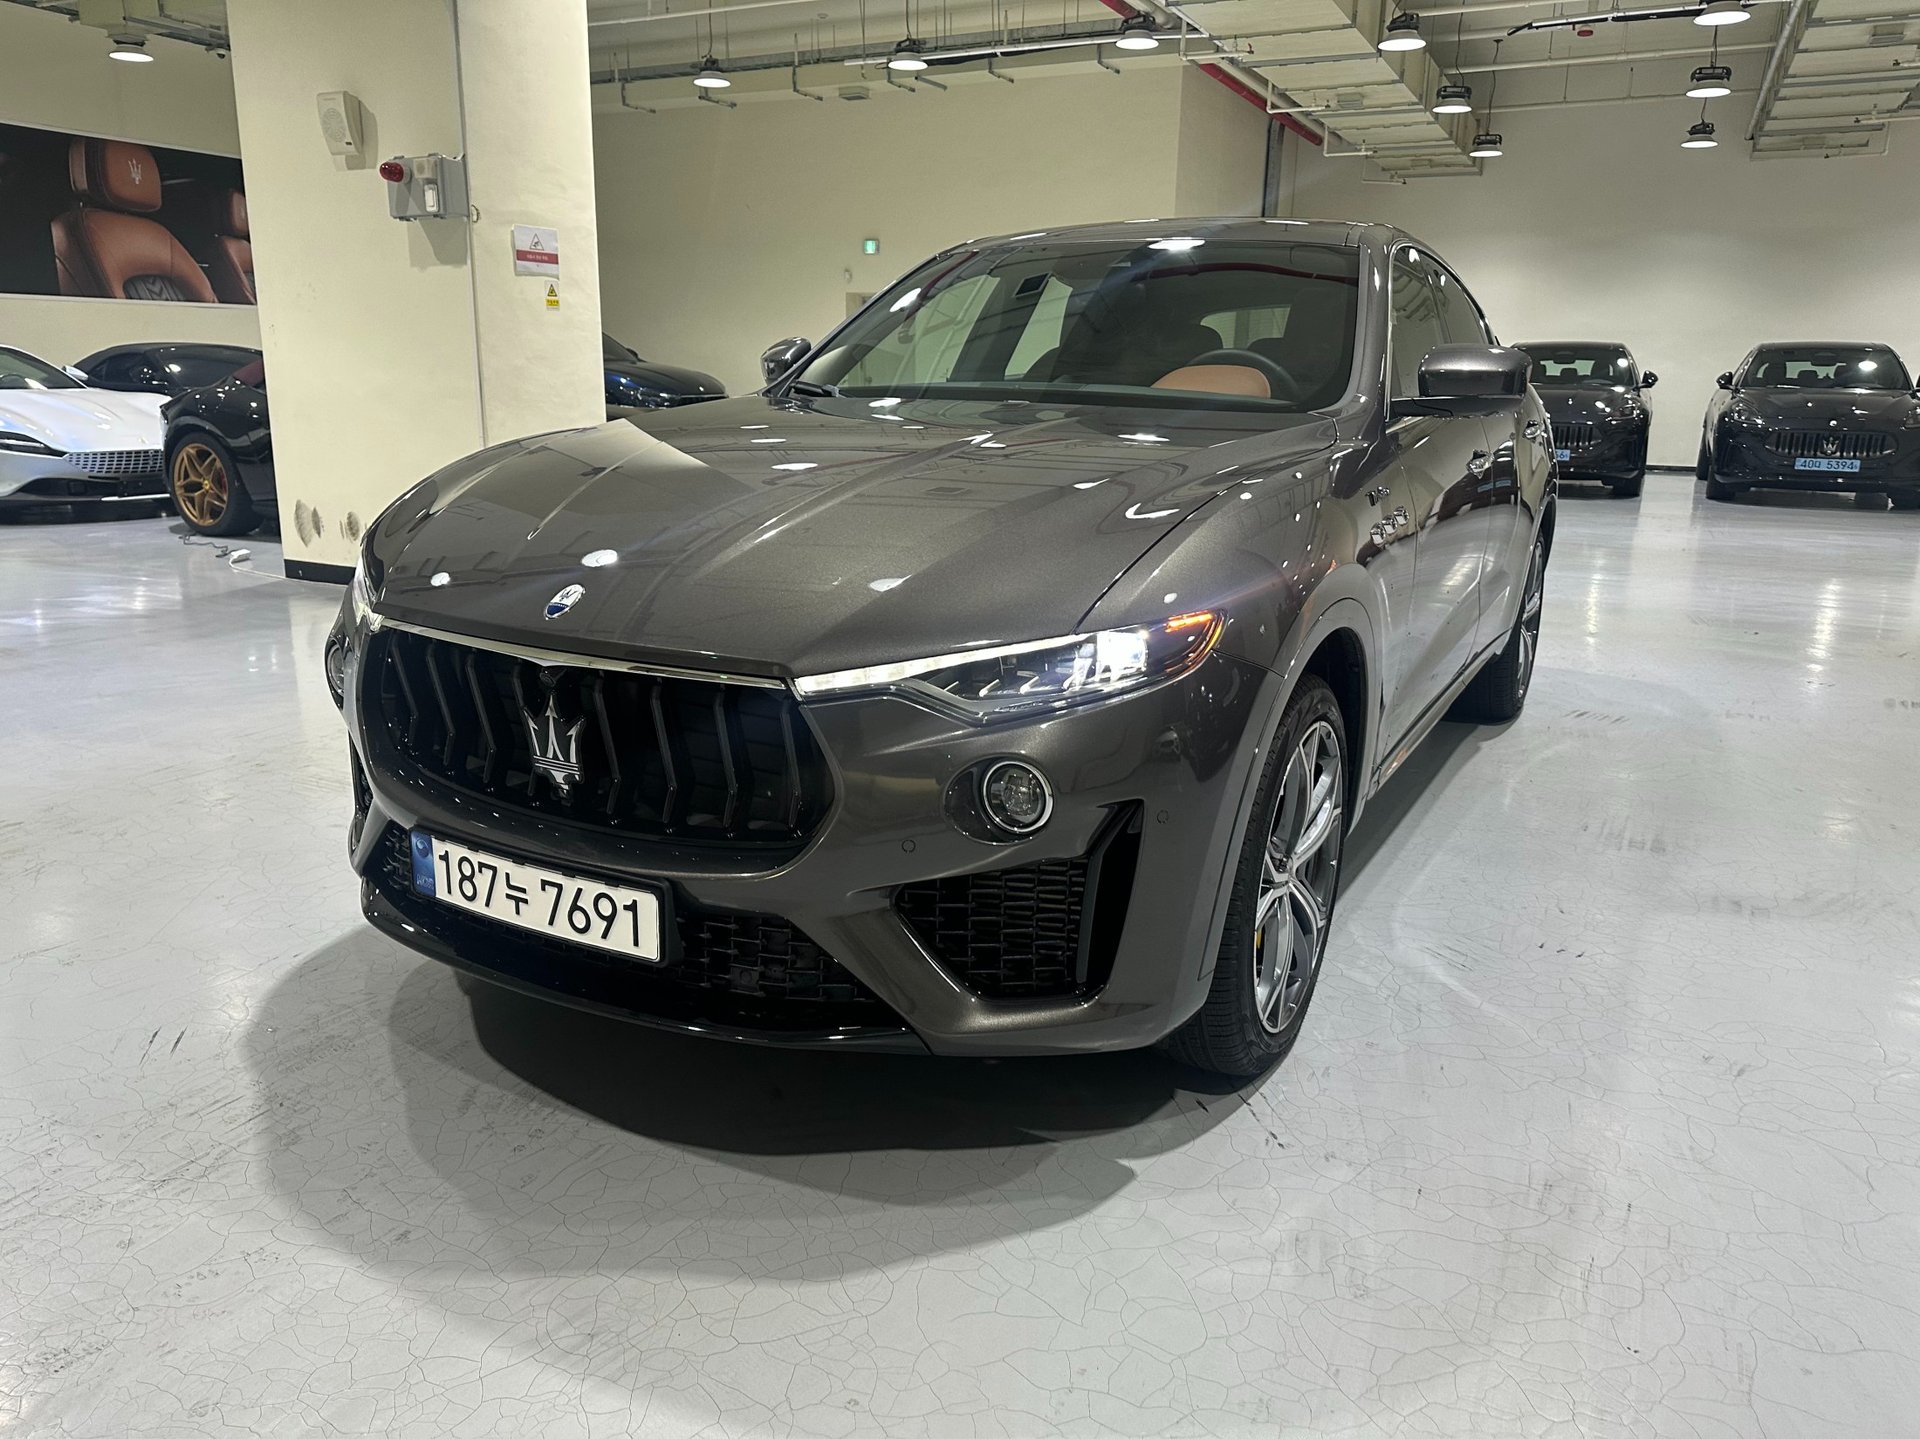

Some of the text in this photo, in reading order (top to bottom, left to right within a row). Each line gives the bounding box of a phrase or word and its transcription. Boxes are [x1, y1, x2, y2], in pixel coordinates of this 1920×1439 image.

[1826, 460, 1854, 470] 5394
[438, 849, 640, 947] 187누 7691
